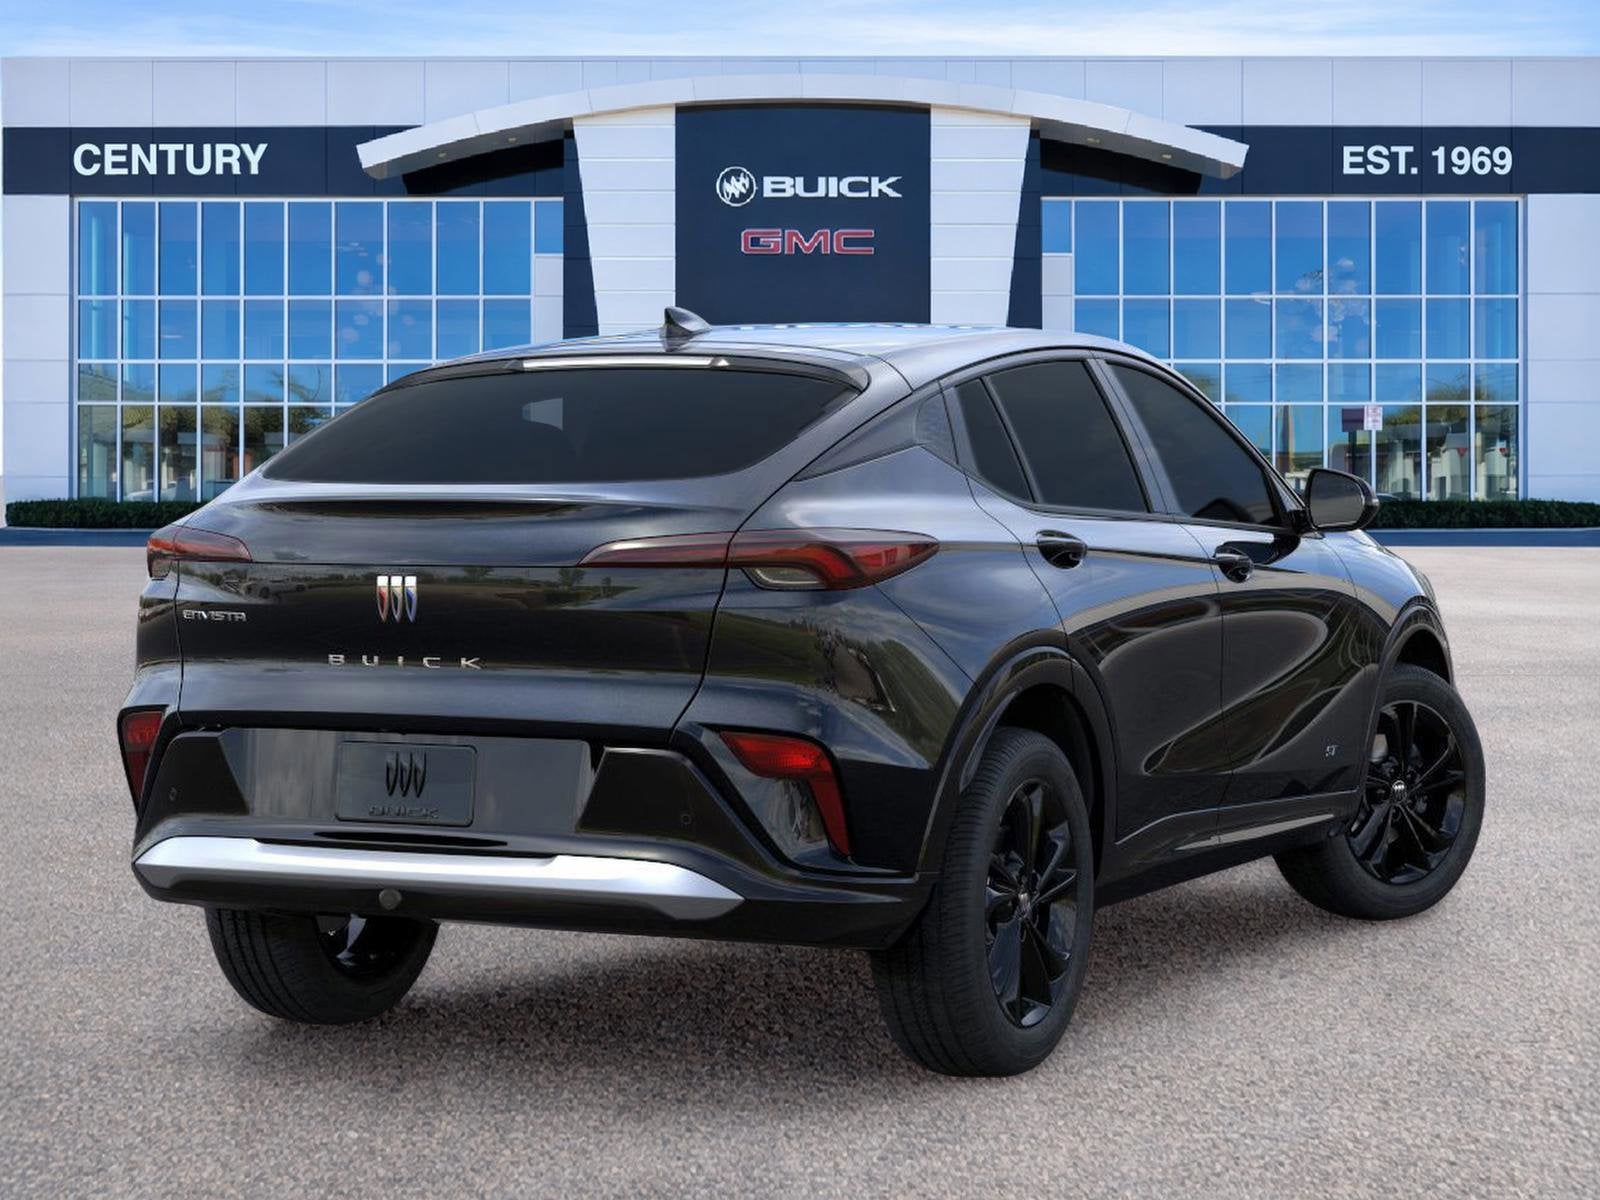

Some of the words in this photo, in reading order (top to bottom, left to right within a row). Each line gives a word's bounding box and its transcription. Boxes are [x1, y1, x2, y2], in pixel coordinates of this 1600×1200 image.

[73, 143, 268, 176] CENTURY
[1342, 145, 1418, 175] EST.
[1431, 145, 1513, 175] 1969
[763, 176, 902, 198] BUICK
[741, 228, 875, 255] GMC
[328, 654, 484, 670] BUICK
